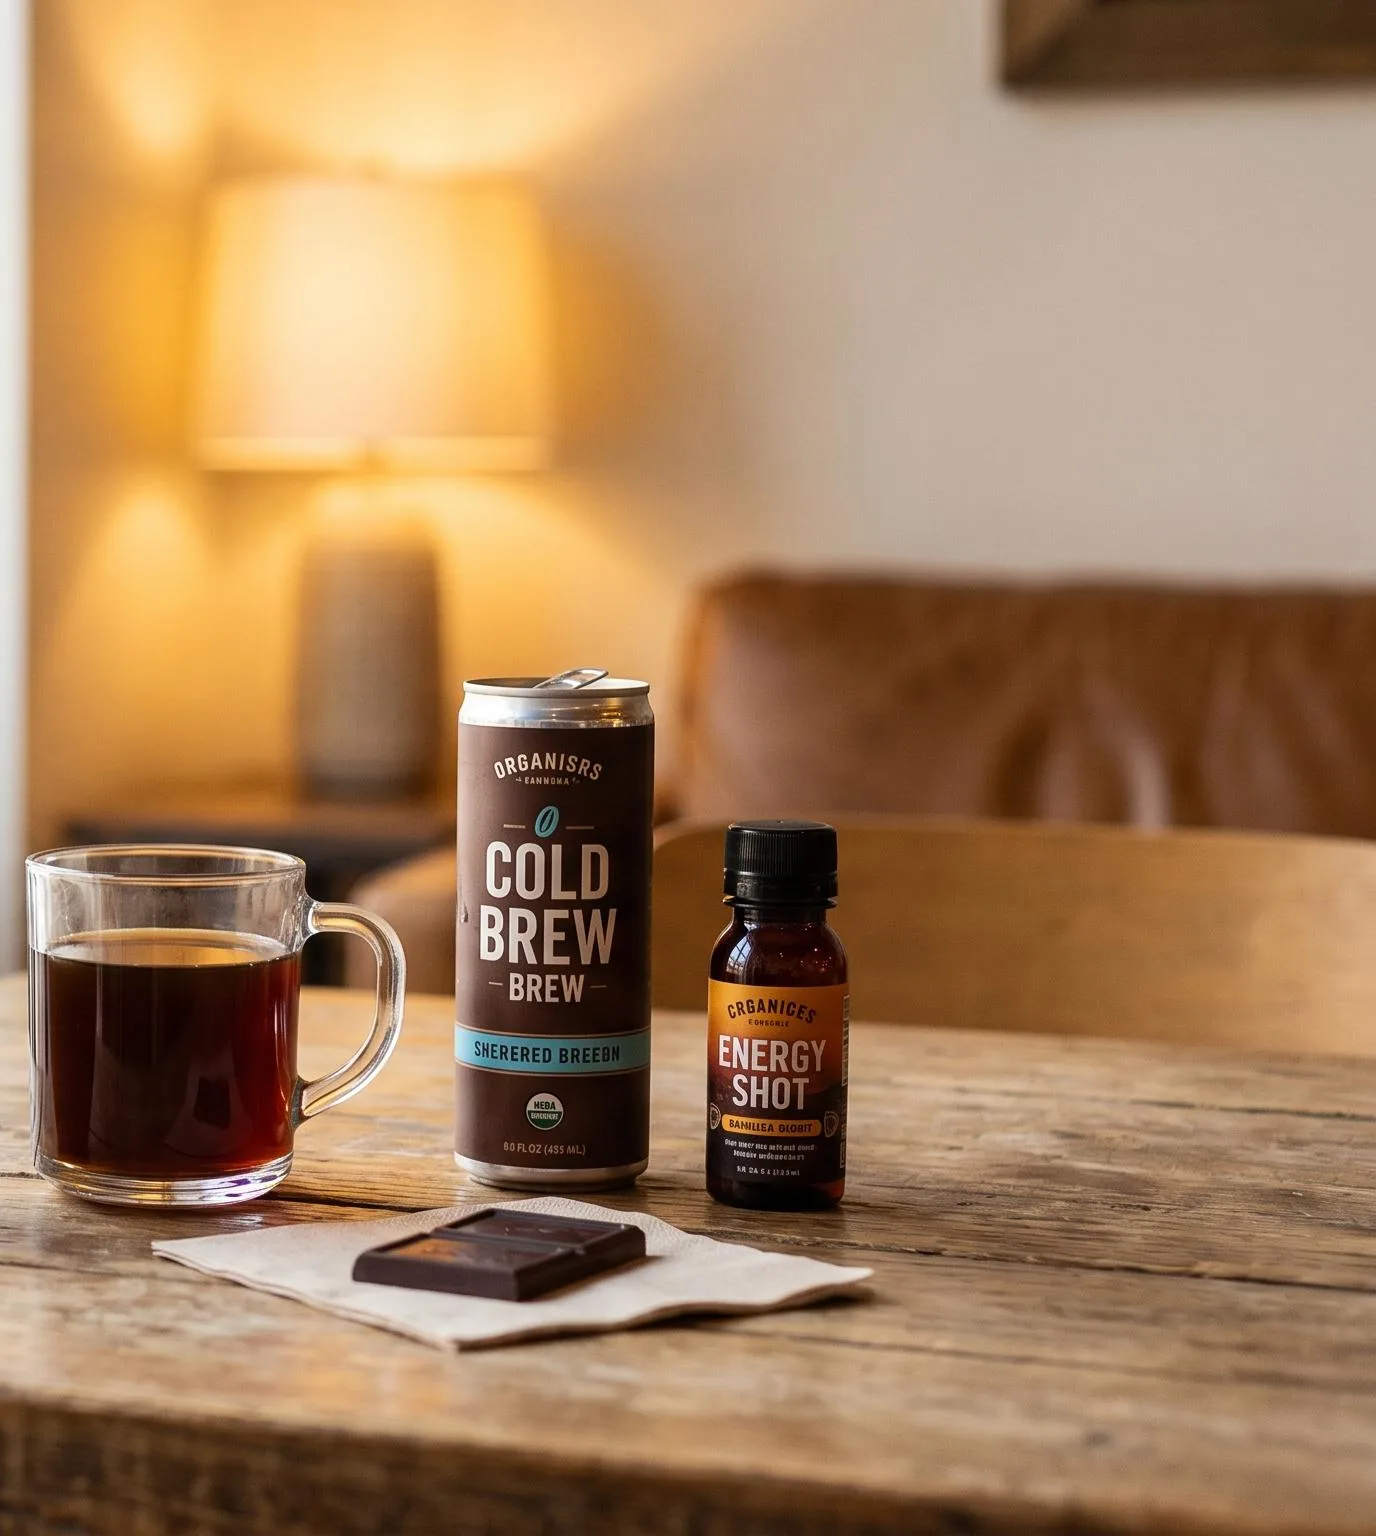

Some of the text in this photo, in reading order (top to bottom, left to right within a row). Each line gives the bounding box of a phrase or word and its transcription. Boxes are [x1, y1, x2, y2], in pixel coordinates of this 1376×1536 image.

[494, 752, 602, 780] ORGANISRS
[486, 841, 609, 900] COLD
[480, 905, 617, 965] BREW
[509, 972, 585, 1002] BREW
[474, 1041, 552, 1064] SHERERED
[719, 1034, 826, 1073] ENERGY
[732, 1073, 809, 1110] SHOT
